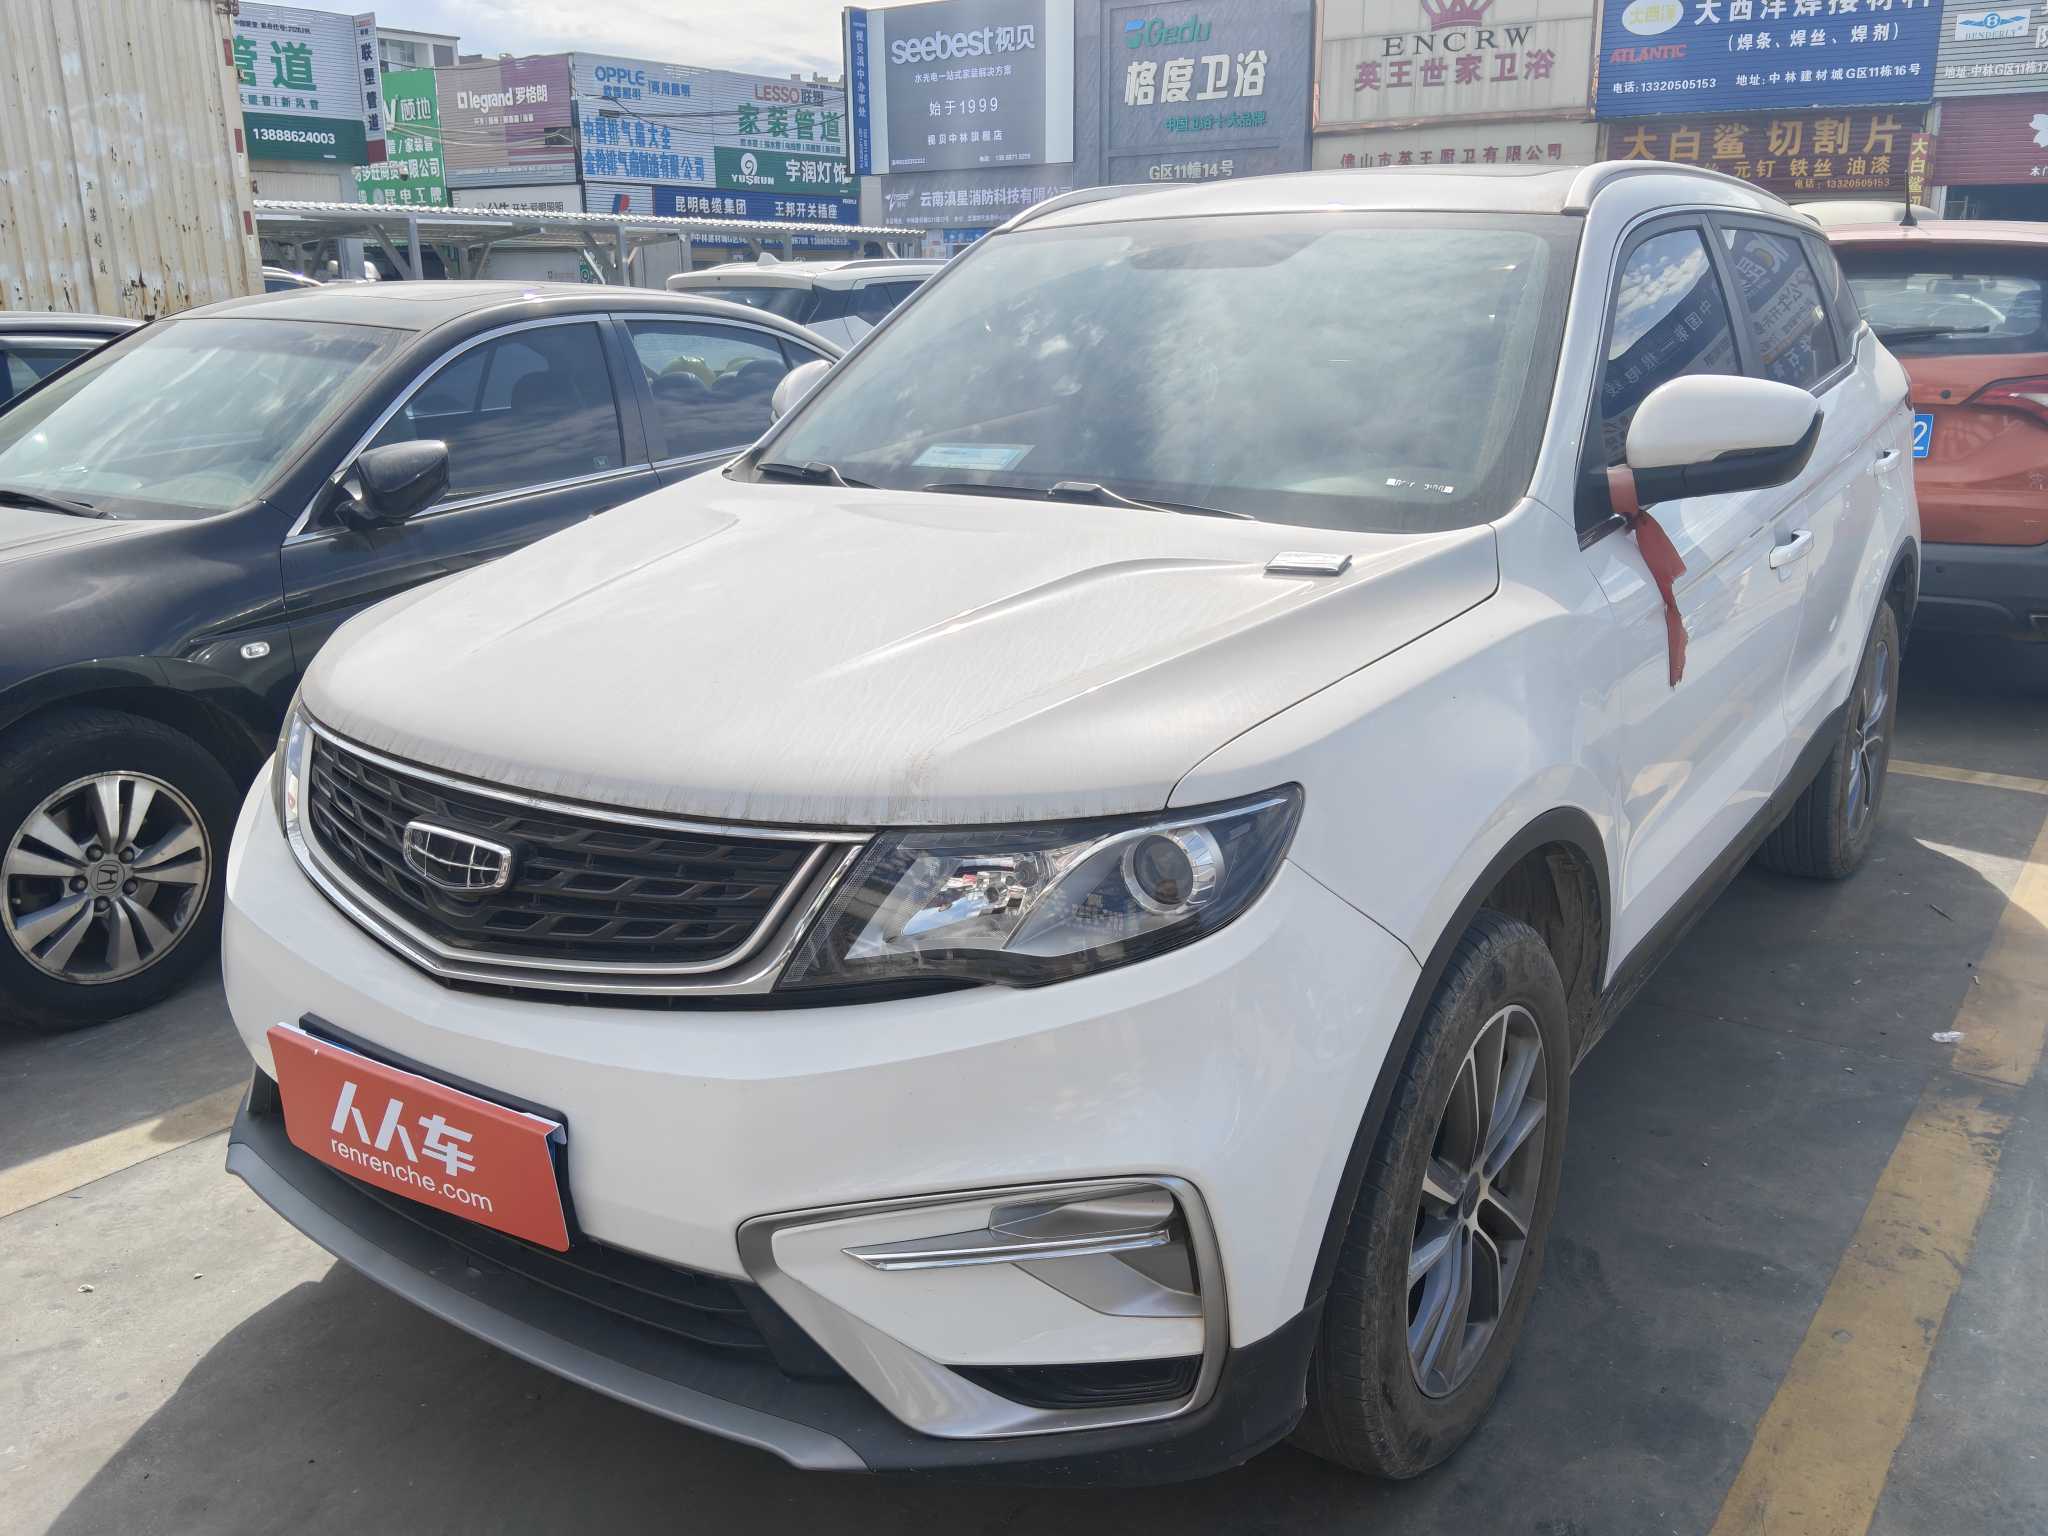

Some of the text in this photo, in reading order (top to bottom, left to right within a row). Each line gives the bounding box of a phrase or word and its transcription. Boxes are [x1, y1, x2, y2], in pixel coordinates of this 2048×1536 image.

[1694, 0, 1930, 26] 大西洋焊接
[892, 25, 1036, 64] seebest 视贝
[1382, 26, 1532, 57] ENCRW
[595, 66, 645, 86] OPPLE
[1125, 50, 1268, 106] 格度卫浴
[1355, 49, 1555, 92] 英王世家卫浴
[468, 84, 549, 114] legrand 罗格朗
[753, 84, 800, 104] LESSO
[252, 127, 336, 145] 13888624003
[737, 103, 841, 142] 家装管道
[1622, 112, 1902, 162] 大白鲨切割片
[1847, 155, 1891, 177] 油漆
[675, 195, 747, 216] 昆明电缆集团
[330, 1080, 477, 1178] 人人车
[329, 1138, 494, 1214] renrenche.com
